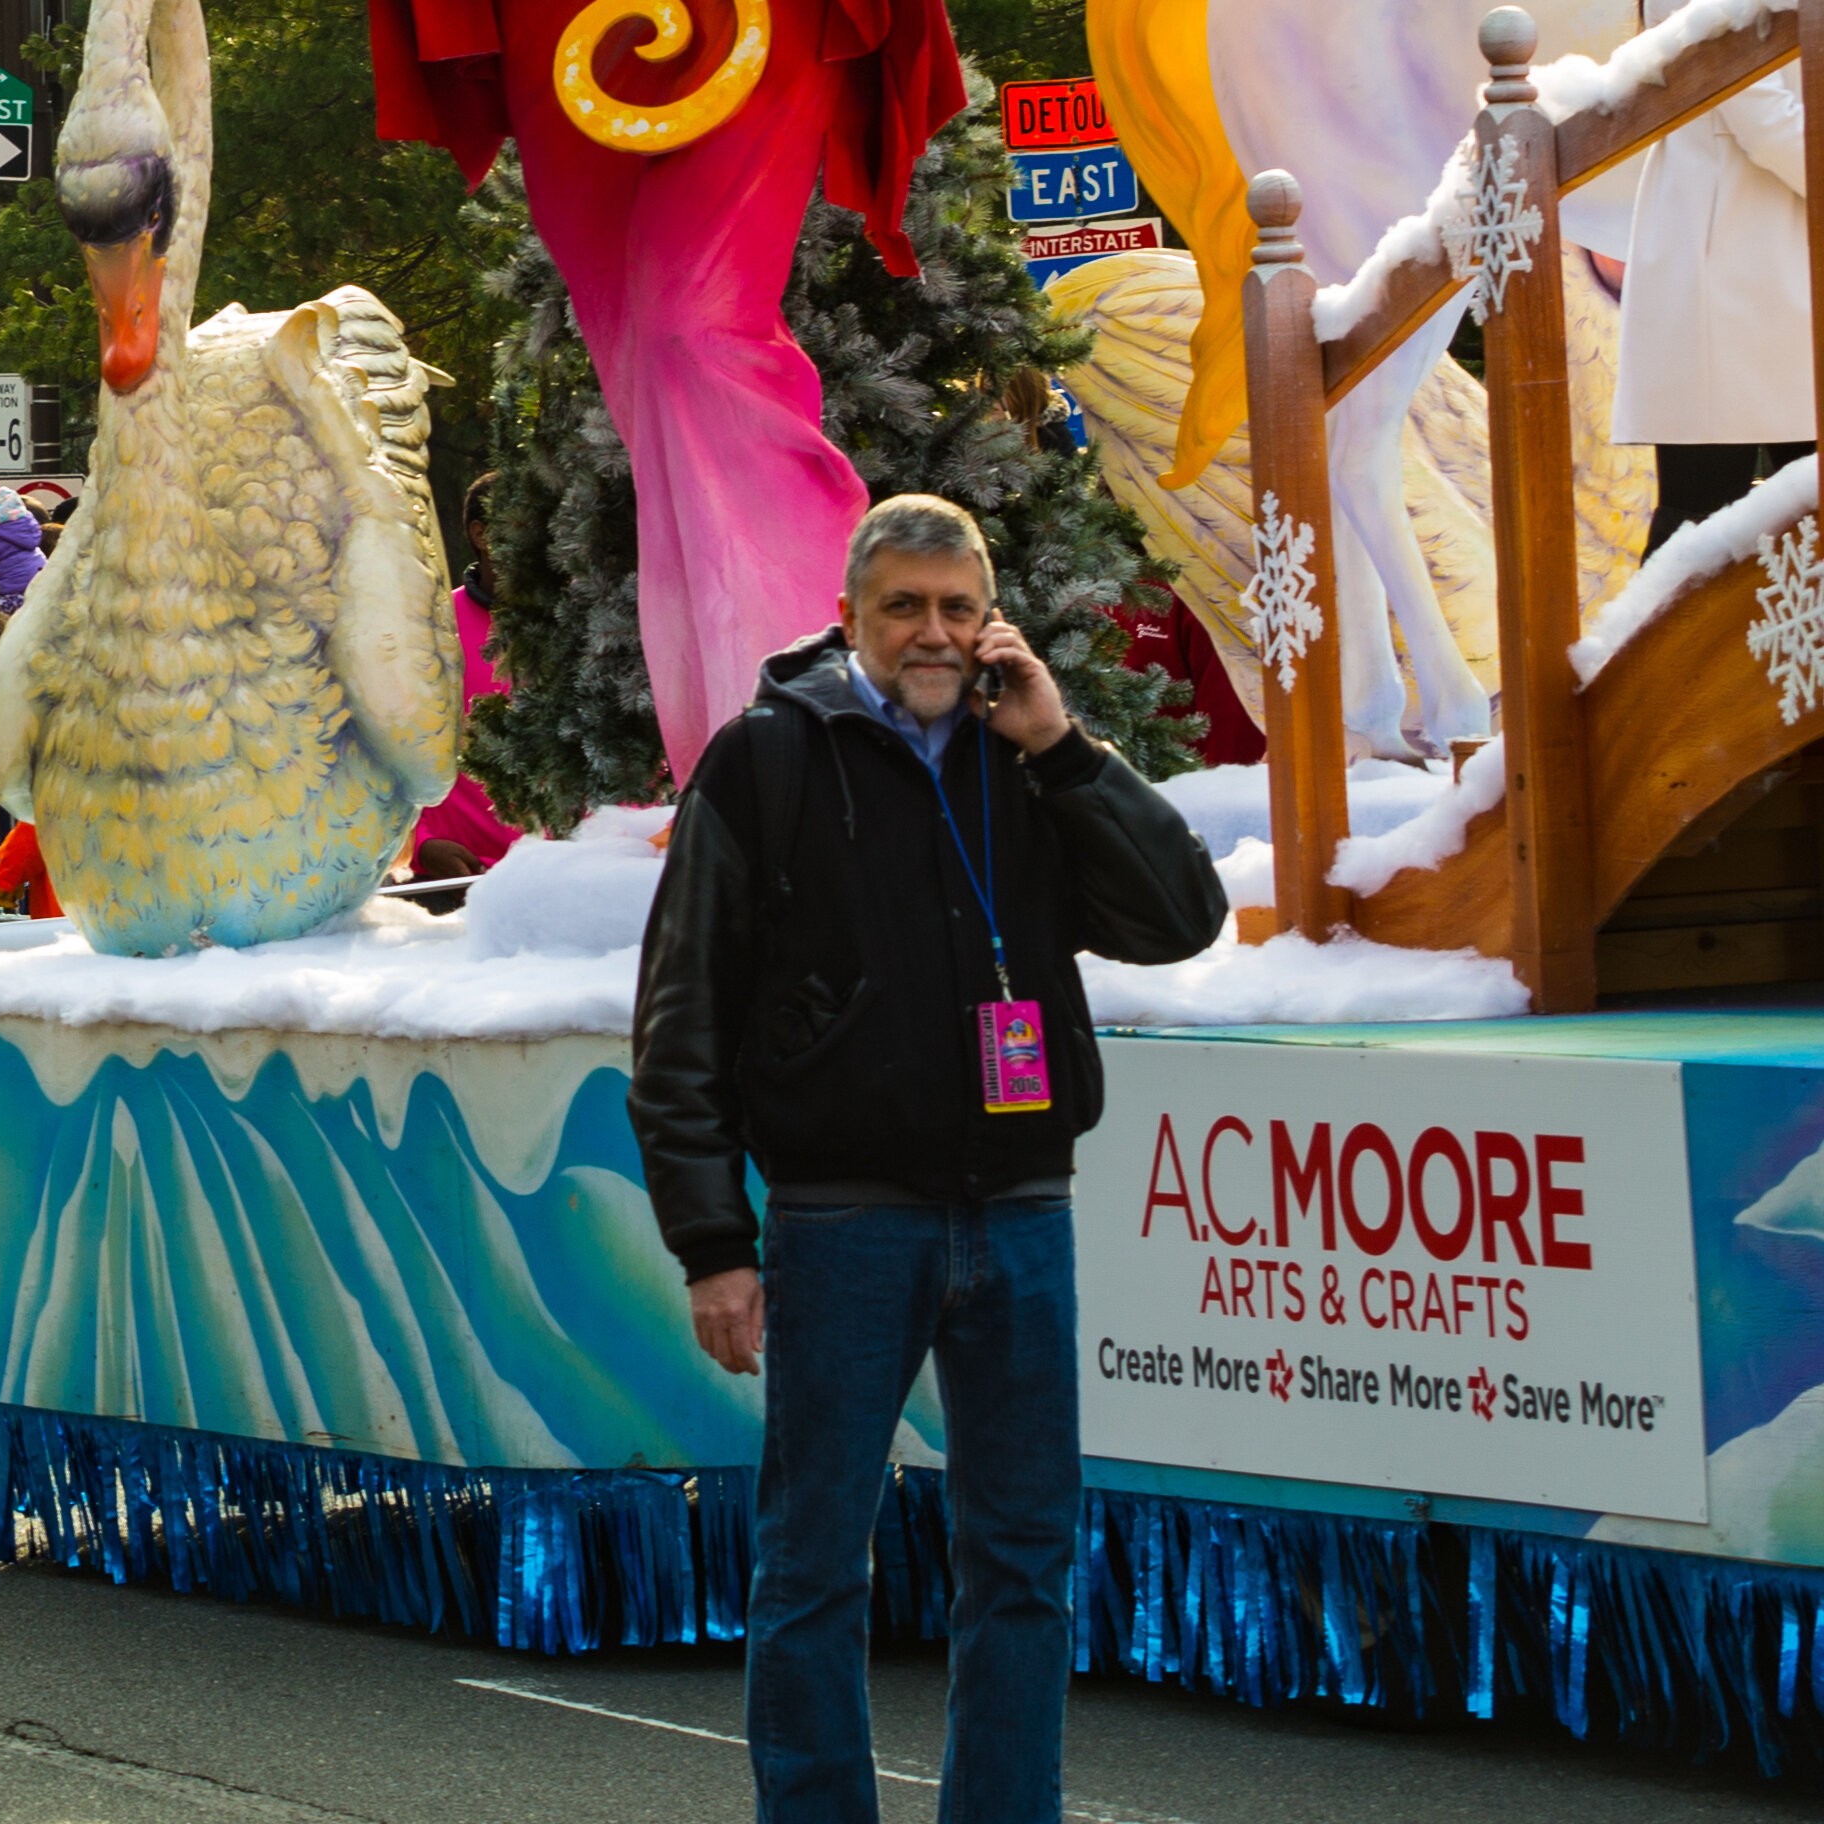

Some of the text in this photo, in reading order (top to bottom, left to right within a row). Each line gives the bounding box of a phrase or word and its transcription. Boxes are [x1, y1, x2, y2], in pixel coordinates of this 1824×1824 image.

[1019, 93, 1107, 134] DETOU
[1031, 161, 1119, 205] EAST
[1030, 231, 1142, 258] INTERSTATE
[1008, 1076, 1042, 1094] 2016
[1200, 1255, 1529, 1342] ARTS & CRAFTS
[1098, 1336, 1184, 1387] Create
[1193, 1346, 1261, 1393] More
[1300, 1355, 1380, 1405] Share
[1390, 1363, 1462, 1413] More
[1503, 1373, 1571, 1423] Save
